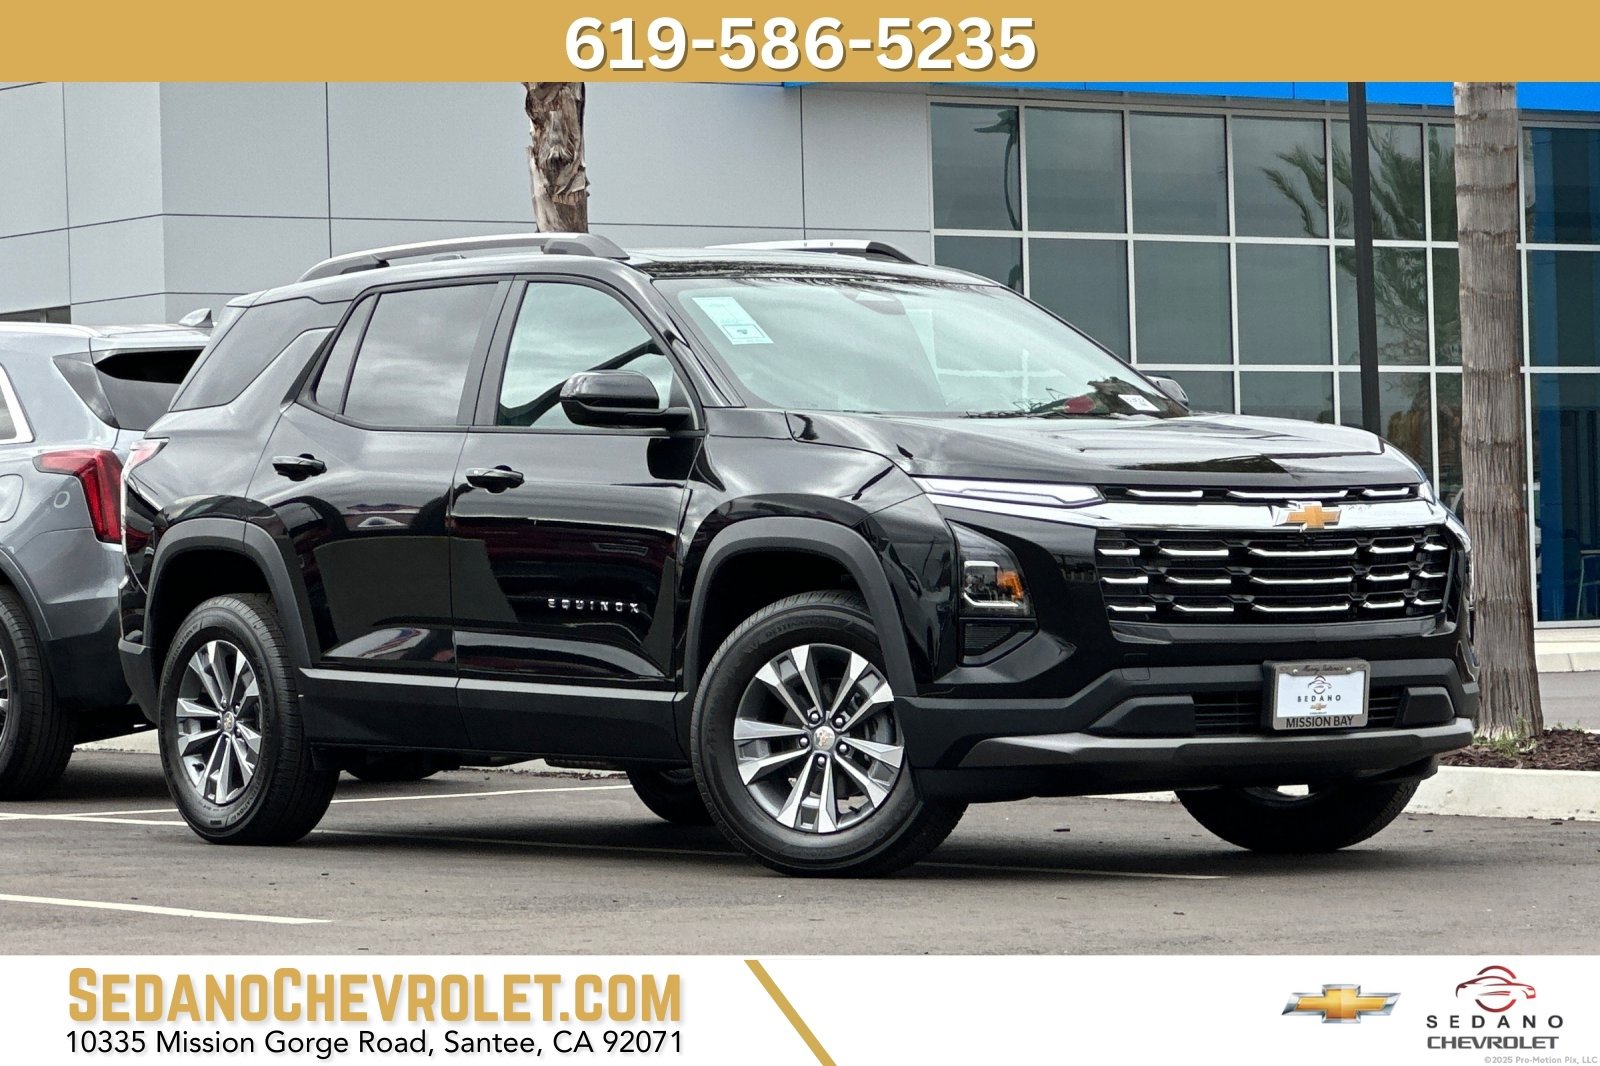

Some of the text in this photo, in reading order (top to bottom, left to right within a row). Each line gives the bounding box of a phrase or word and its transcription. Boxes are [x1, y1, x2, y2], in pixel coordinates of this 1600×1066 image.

[547, 598, 640, 613] EQUINOX
[1297, 694, 1342, 703] SEDANO
[1285, 715, 1354, 729] MISSION BAY
